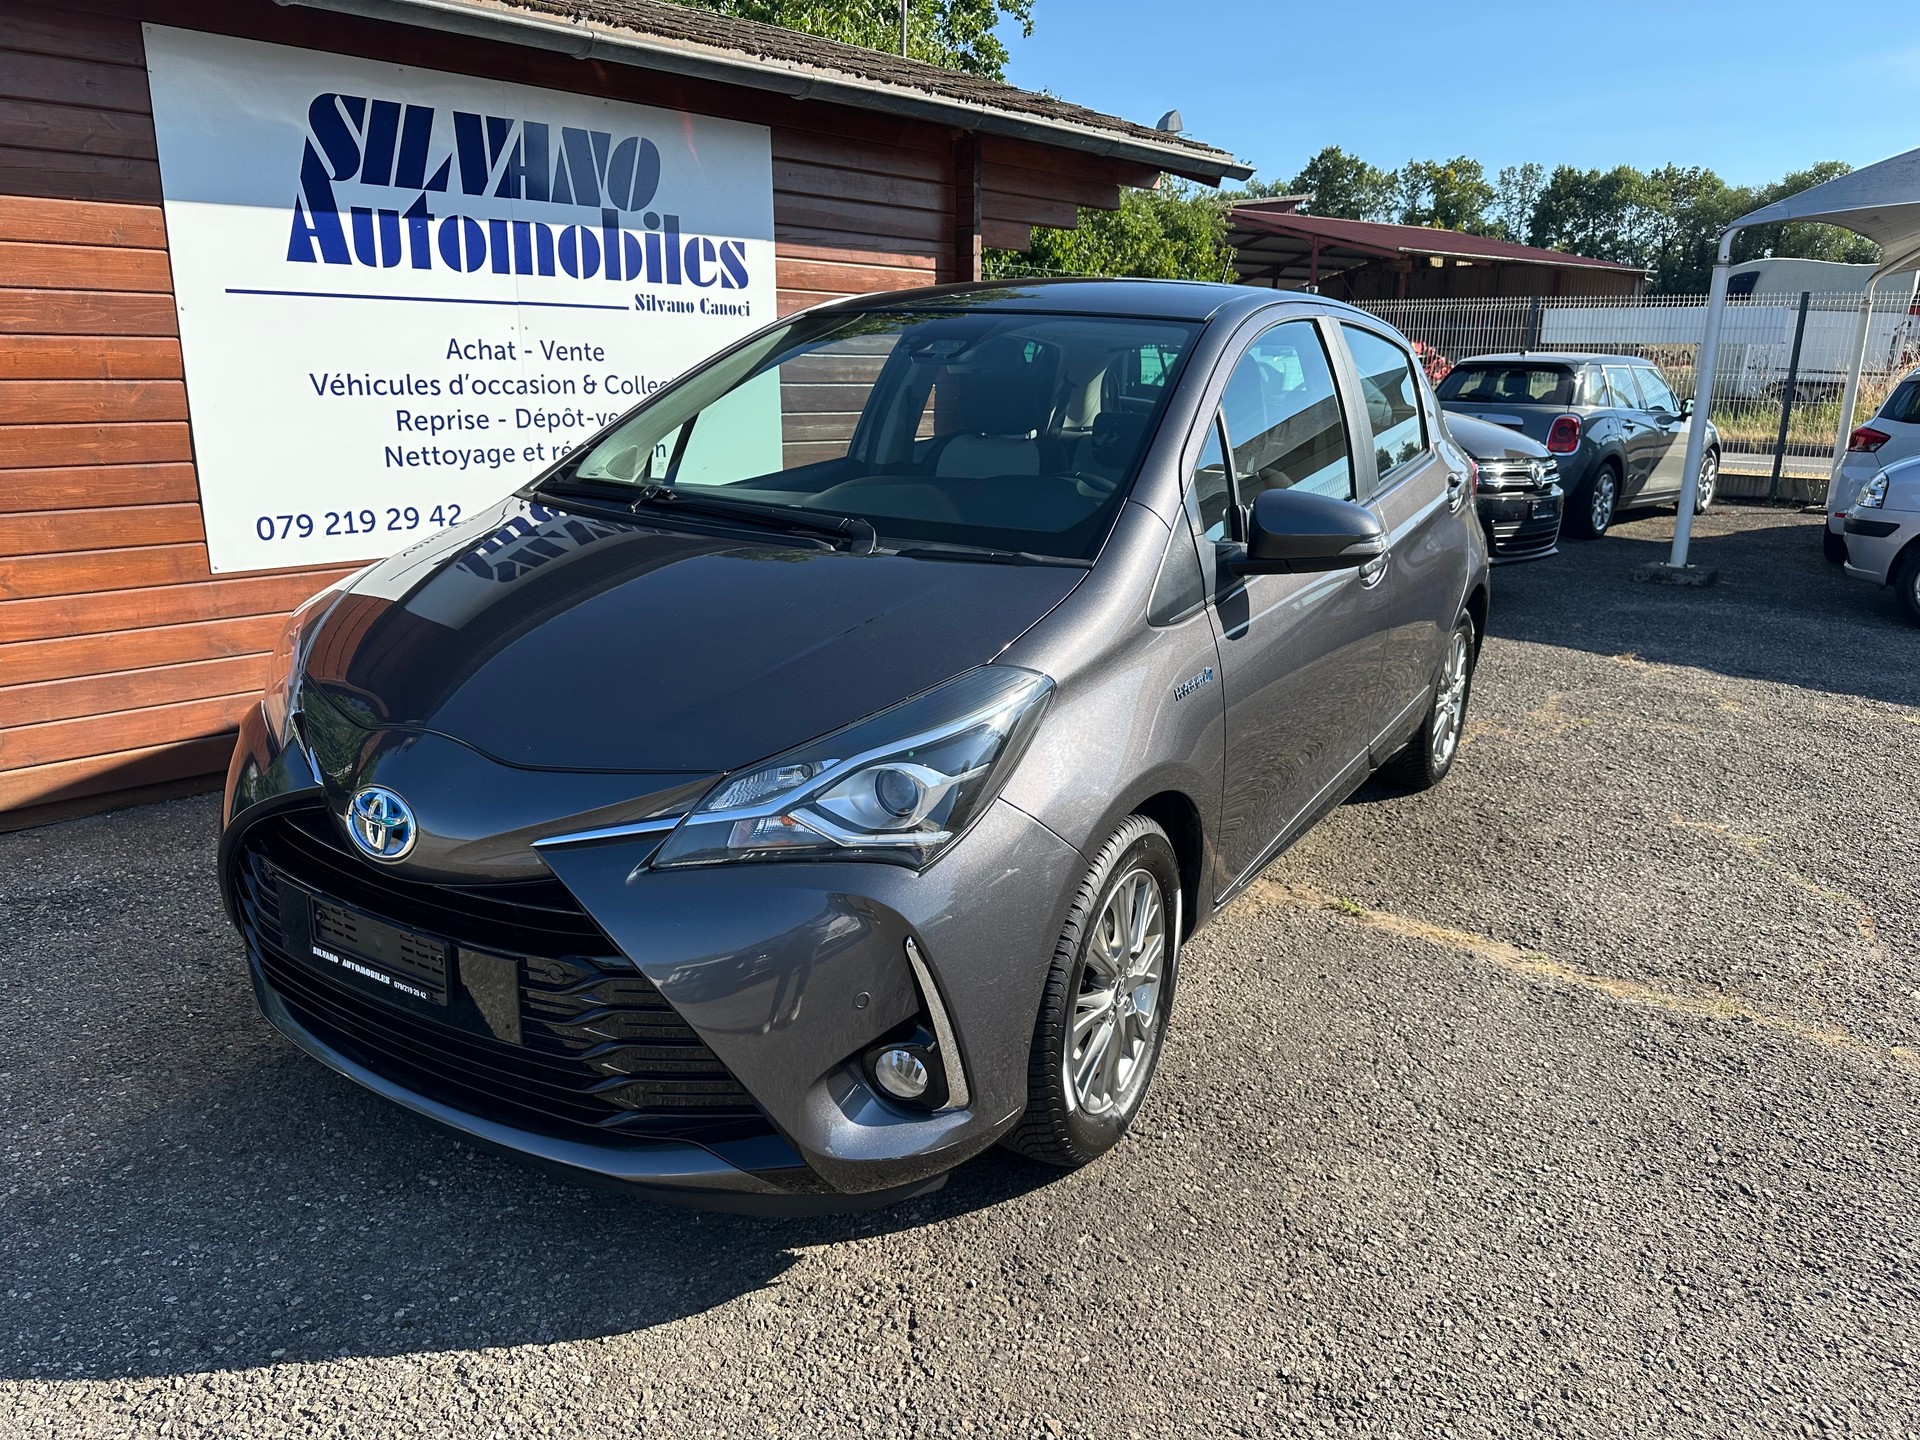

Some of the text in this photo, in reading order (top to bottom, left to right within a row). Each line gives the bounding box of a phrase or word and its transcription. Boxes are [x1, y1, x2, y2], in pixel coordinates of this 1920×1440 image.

[308, 92, 661, 212] SILVANO
[286, 134, 750, 290] Automobiles
[634, 293, 751, 317] Silvano Canoci
[446, 338, 517, 361] Achat
[539, 339, 605, 362] Vente
[308, 373, 442, 397] Véhicules
[583, 374, 598, 395] &
[396, 408, 490, 437] Reprise
[384, 445, 516, 471] Nettoyage
[522, 442, 545, 462] et
[256, 503, 462, 541] 079 219 29 42
[312, 946, 339, 963] SILVANO
[342, 959, 390, 984] AUTOMOBILES
[420, 990, 427, 999] 42
